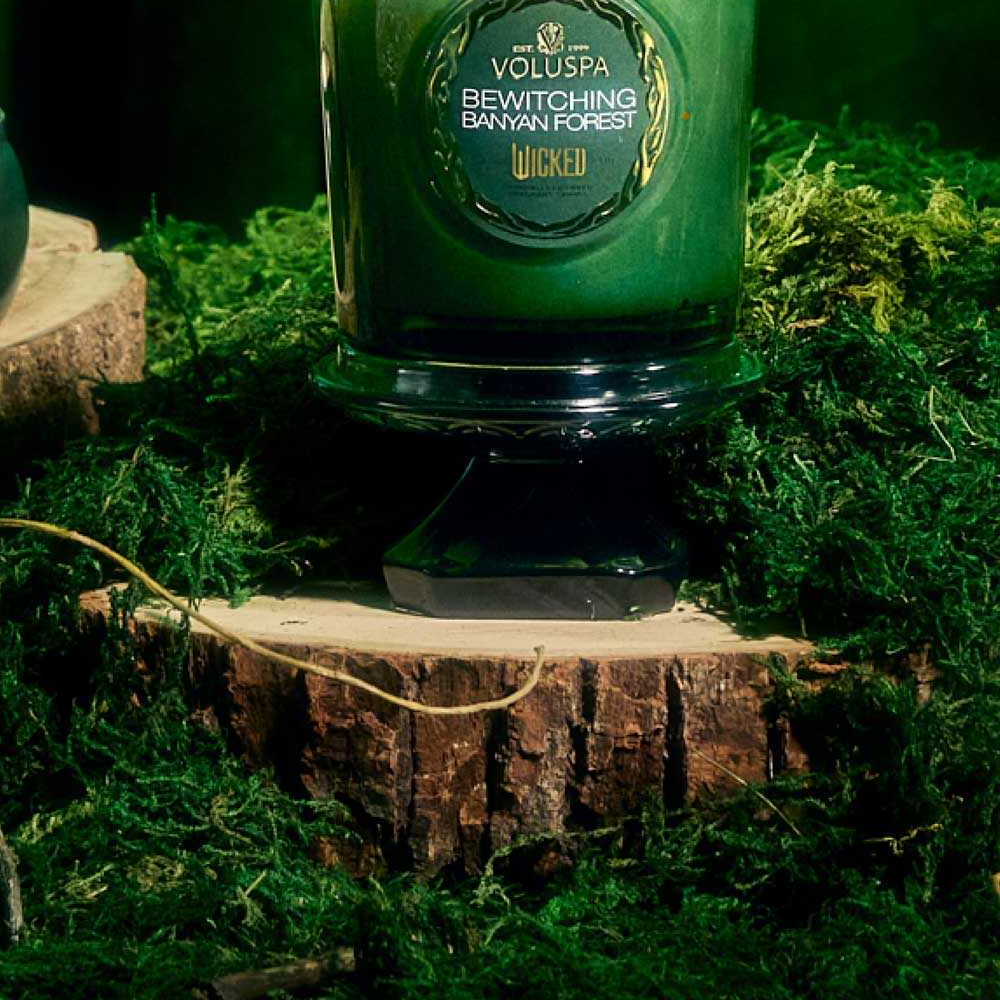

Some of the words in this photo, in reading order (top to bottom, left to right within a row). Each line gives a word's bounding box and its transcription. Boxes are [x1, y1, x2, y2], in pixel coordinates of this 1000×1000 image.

[491, 56, 609, 80] VOLUSPA
[462, 88, 637, 111] BEWITCHING
[462, 111, 548, 132] BANYAN
[554, 110, 637, 131] FOREST
[511, 143, 587, 181] WICKED
